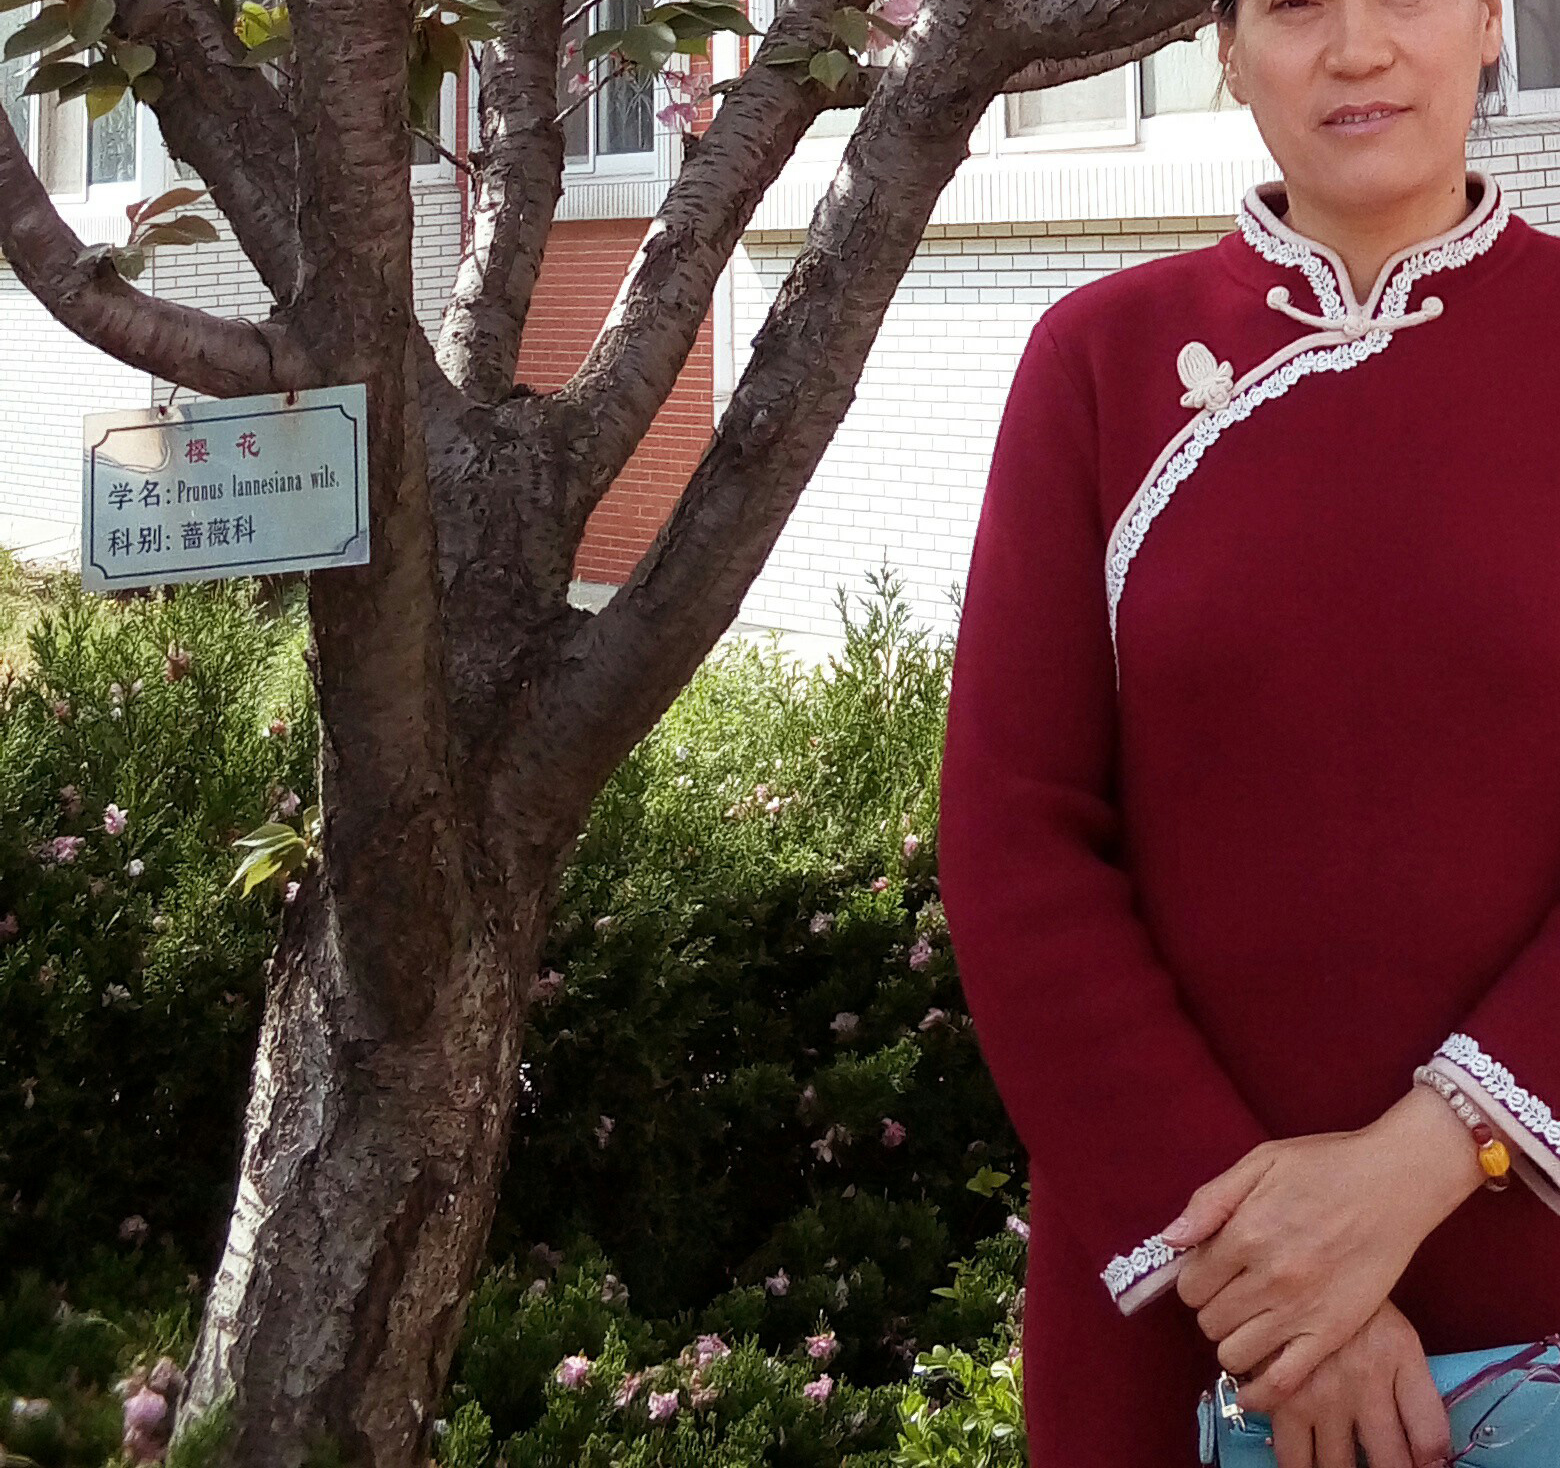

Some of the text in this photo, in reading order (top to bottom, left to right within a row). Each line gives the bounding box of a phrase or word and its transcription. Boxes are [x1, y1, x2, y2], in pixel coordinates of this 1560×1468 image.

[177, 479, 223, 504] Prunus
[232, 470, 302, 497] lannesiana
[310, 467, 341, 489] wils.
